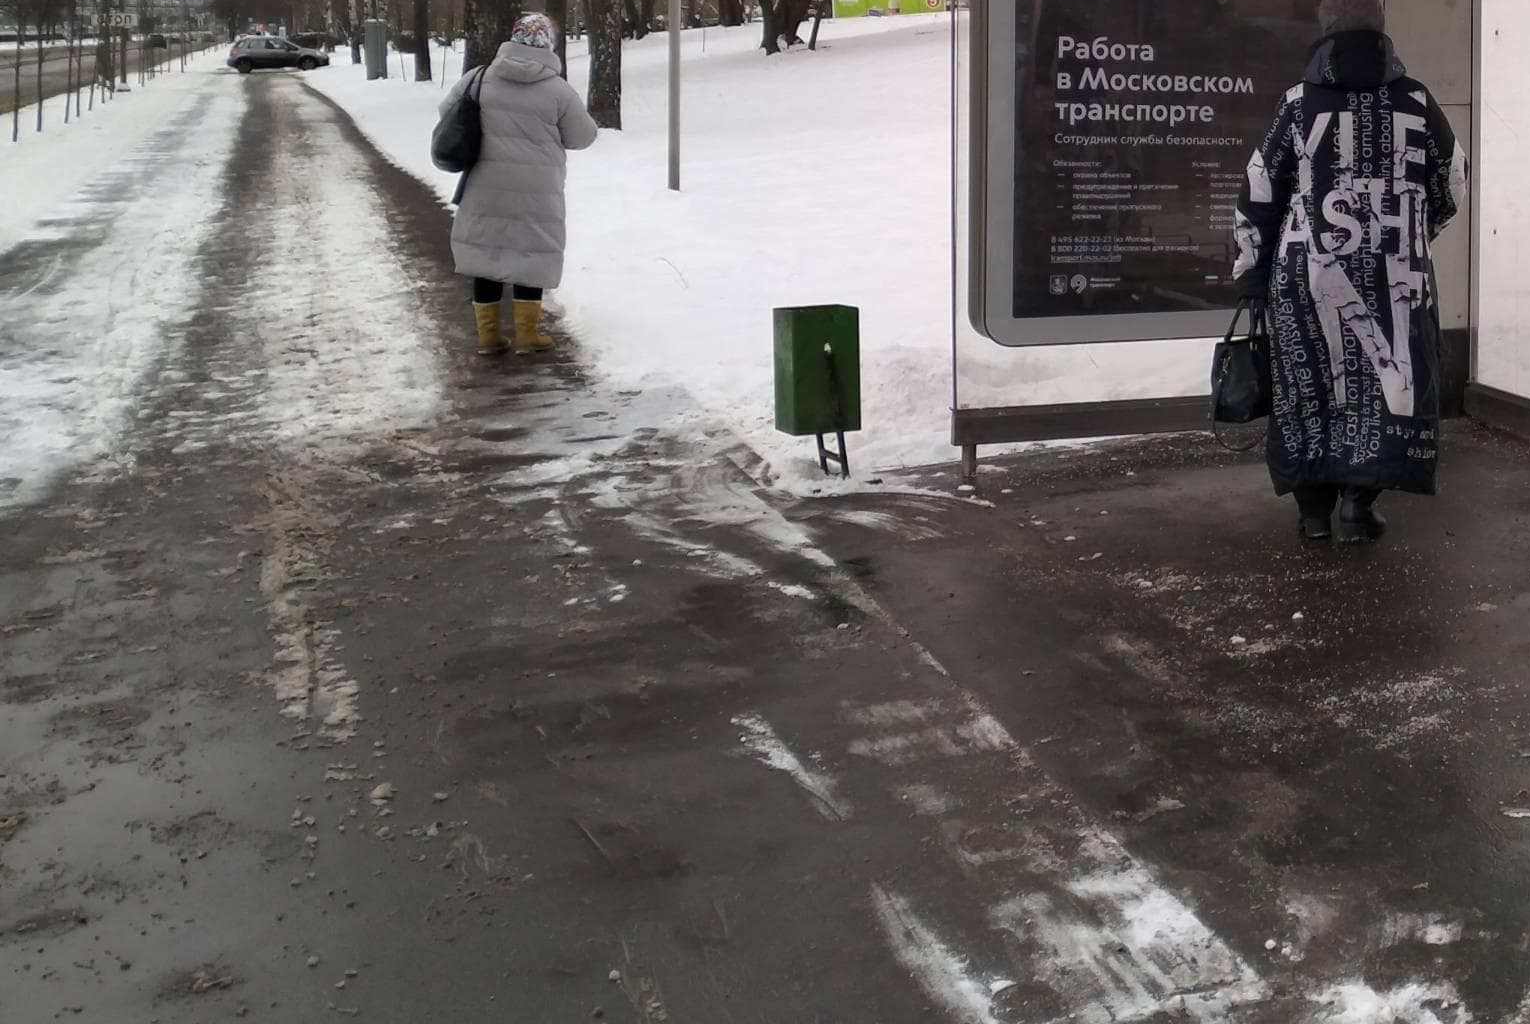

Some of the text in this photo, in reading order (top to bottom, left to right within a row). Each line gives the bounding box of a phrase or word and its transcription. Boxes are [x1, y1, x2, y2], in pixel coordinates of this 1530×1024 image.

[1058, 36, 1154, 62] Работа
[1056, 66, 1254, 94] в Московском
[1054, 101, 1215, 127] транспорте
[1358, 93, 1374, 158] amusing
[1055, 132, 1243, 149] Сотрудник службы безопасности
[1378, 109, 1392, 153] about
[1279, 296, 1306, 362] answer
[1369, 399, 1382, 426] live
[1356, 417, 1370, 465] Success
[1365, 430, 1380, 460] You
